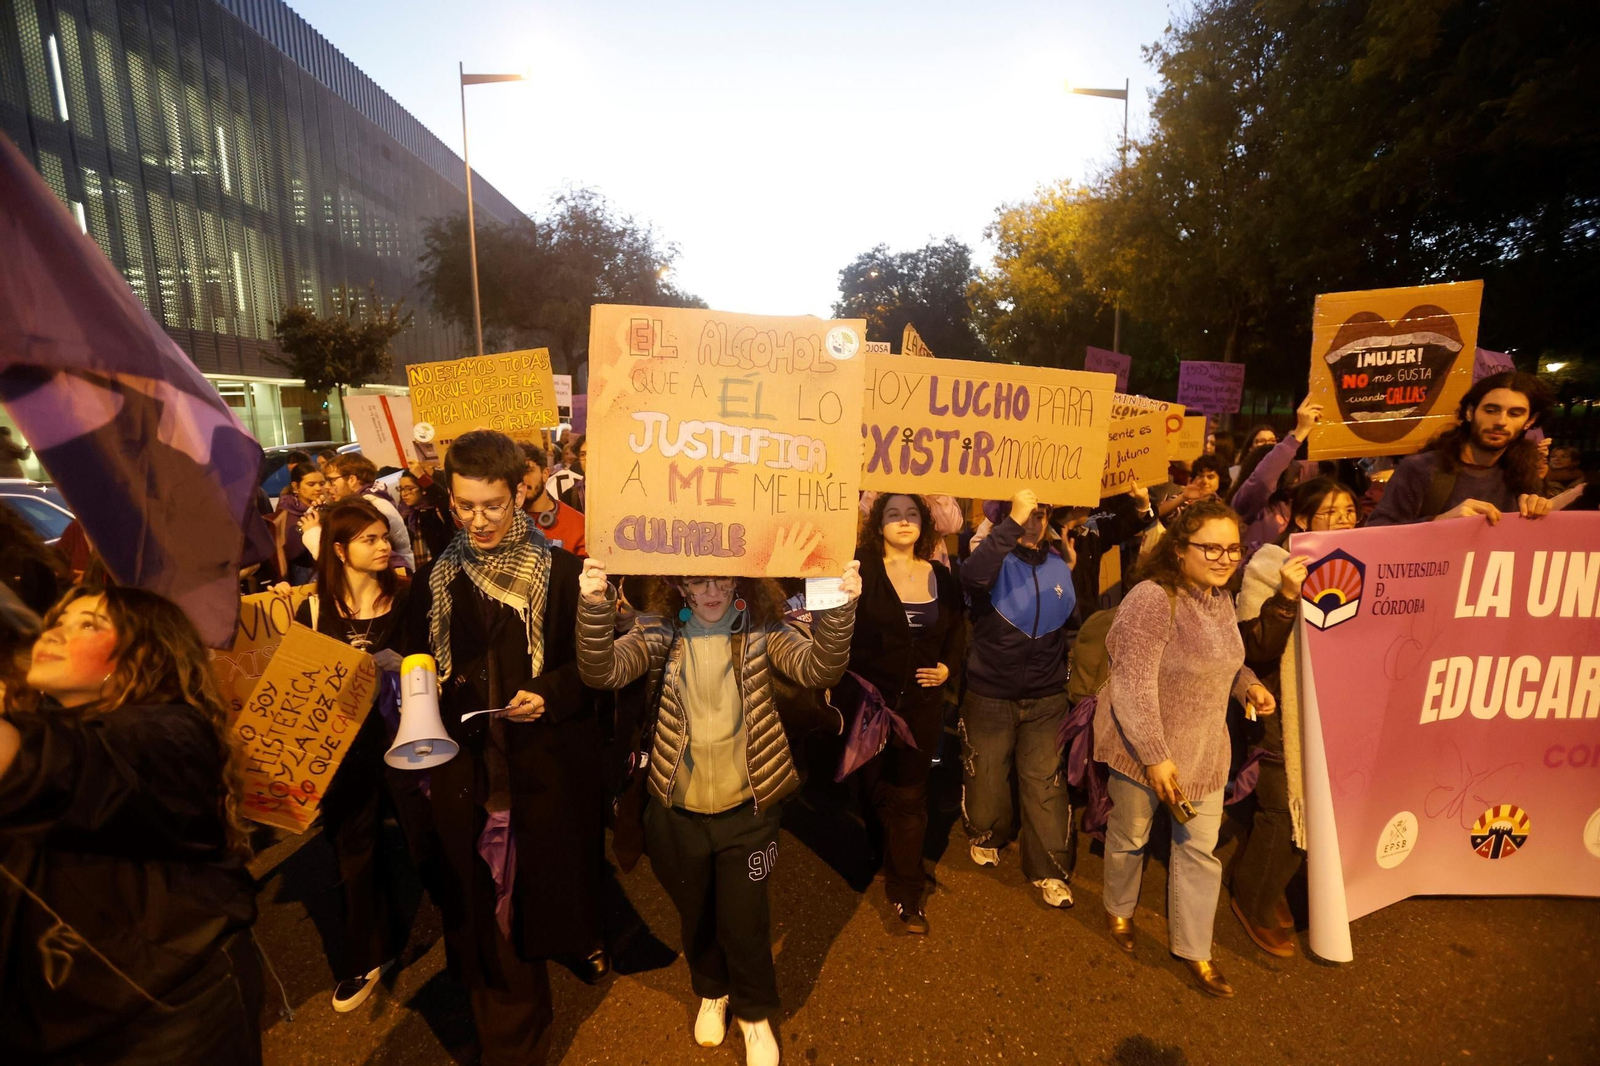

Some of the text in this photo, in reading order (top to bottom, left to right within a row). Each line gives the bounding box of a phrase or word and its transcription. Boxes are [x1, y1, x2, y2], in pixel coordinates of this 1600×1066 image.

[630, 318, 836, 374] EL ALCOHOL
[409, 352, 549, 386] NO ESTAMOS TODAS
[1342, 367, 1432, 389] NO me GUSTA
[415, 380, 469, 407] PORQUE
[472, 374, 520, 396] DESDE
[522, 372, 541, 388] LA
[419, 389, 543, 425] TUMBA NO SE PUEDE
[631, 369, 842, 424] QUE A ÉL LO
[929, 375, 1030, 421] LUCHO
[1036, 386, 1094, 427] PARA
[1345, 386, 1427, 405] cuando CALLAS
[1139, 425, 1151, 435] es
[994, 435, 1083, 482] mañana
[620, 460, 647, 497] A
[753, 474, 788, 515] ME
[614, 515, 746, 557] CULPABLE
[1378, 560, 1450, 579] UNIVERSIDAD
[1454, 551, 1600, 618] LA UN
[1372, 596, 1425, 615] CÓRDOBA
[325, 661, 348, 692] DE
[1419, 655, 1600, 725] EDUCAR
[249, 681, 277, 717] SOY
[301, 693, 337, 733] VOZ
[287, 737, 317, 767] LA
[293, 779, 316, 806] LO
[308, 735, 342, 775] QUE
